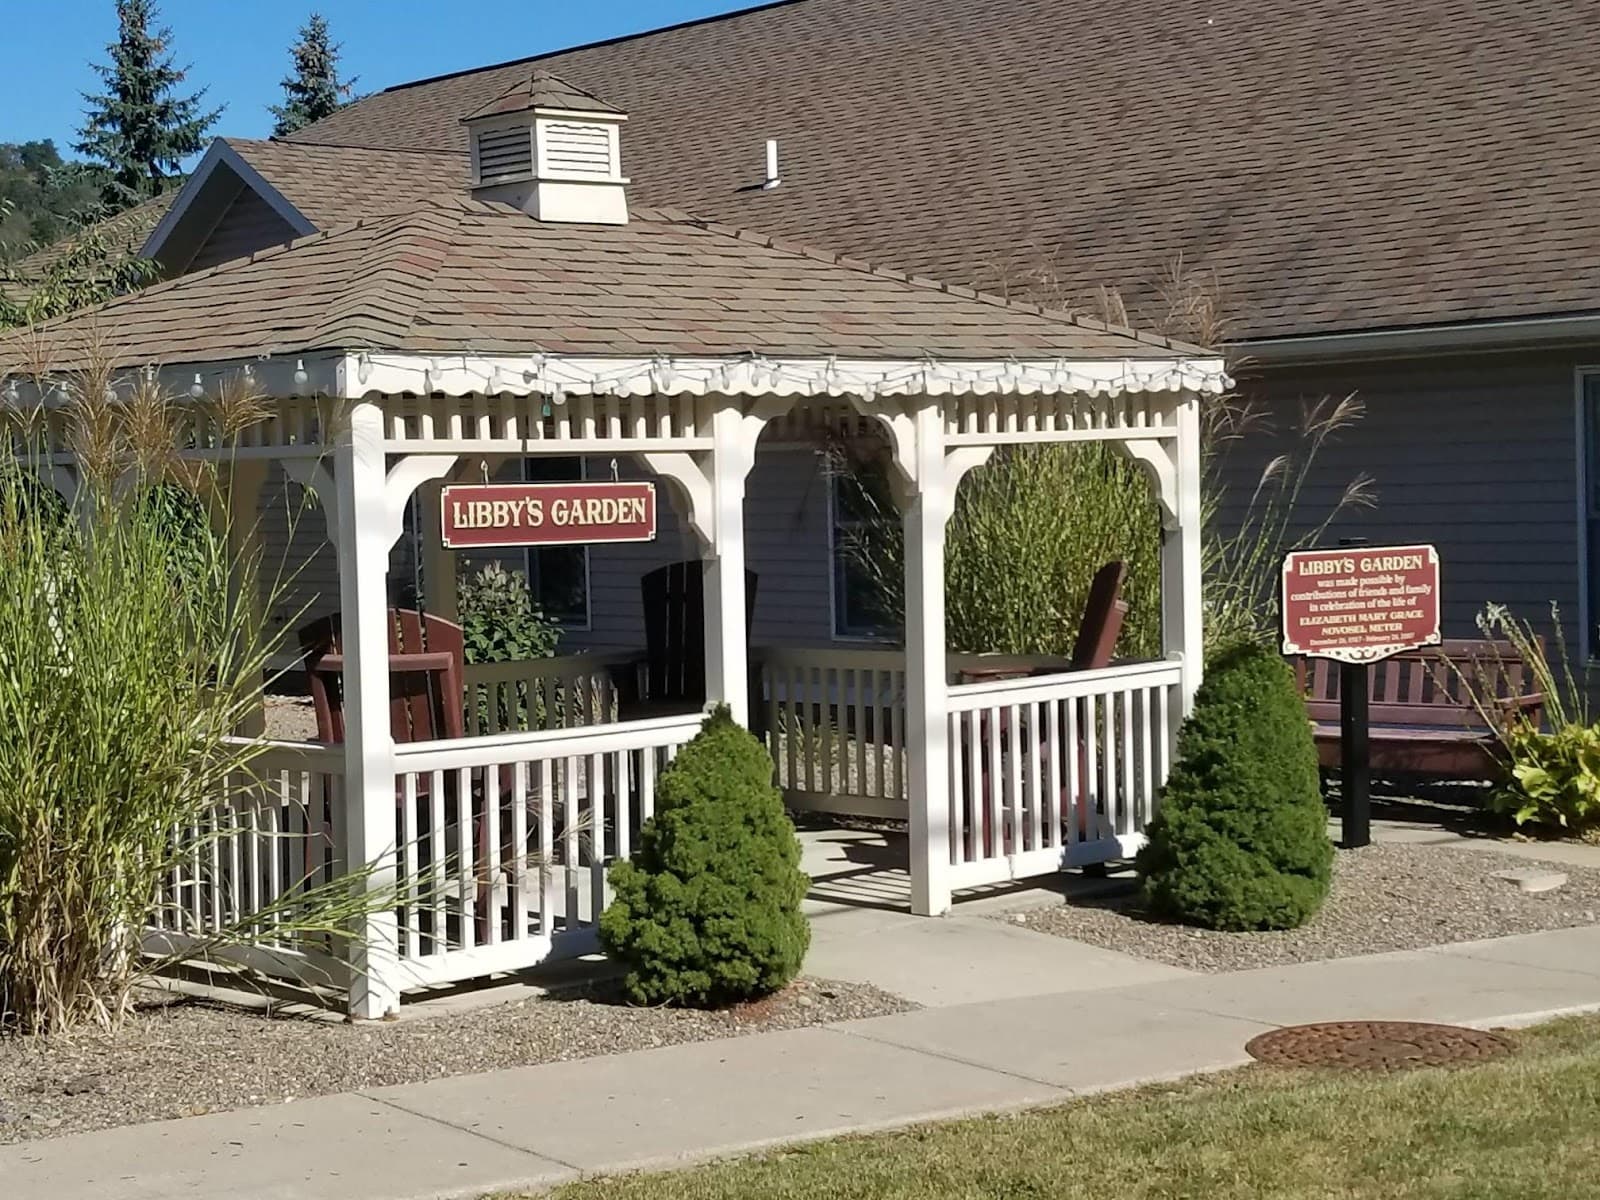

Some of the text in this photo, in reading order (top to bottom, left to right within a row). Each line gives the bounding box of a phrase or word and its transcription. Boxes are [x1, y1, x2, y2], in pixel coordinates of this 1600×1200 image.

[453, 496, 646, 529] LIBBY'S GARDEN
[1299, 555, 1423, 576] LIBBY'S GARDEN
[1317, 574, 1406, 589] was made possible by
[1290, 583, 1431, 601] contributions of friends and family
[1320, 600, 1366, 611] celebration
[1367, 598, 1376, 608] of
[1377, 598, 1391, 608] the
[1392, 596, 1406, 607] life
[1407, 595, 1417, 606] of
[1300, 609, 1424, 626] ELIZABETH MARY GRACE
